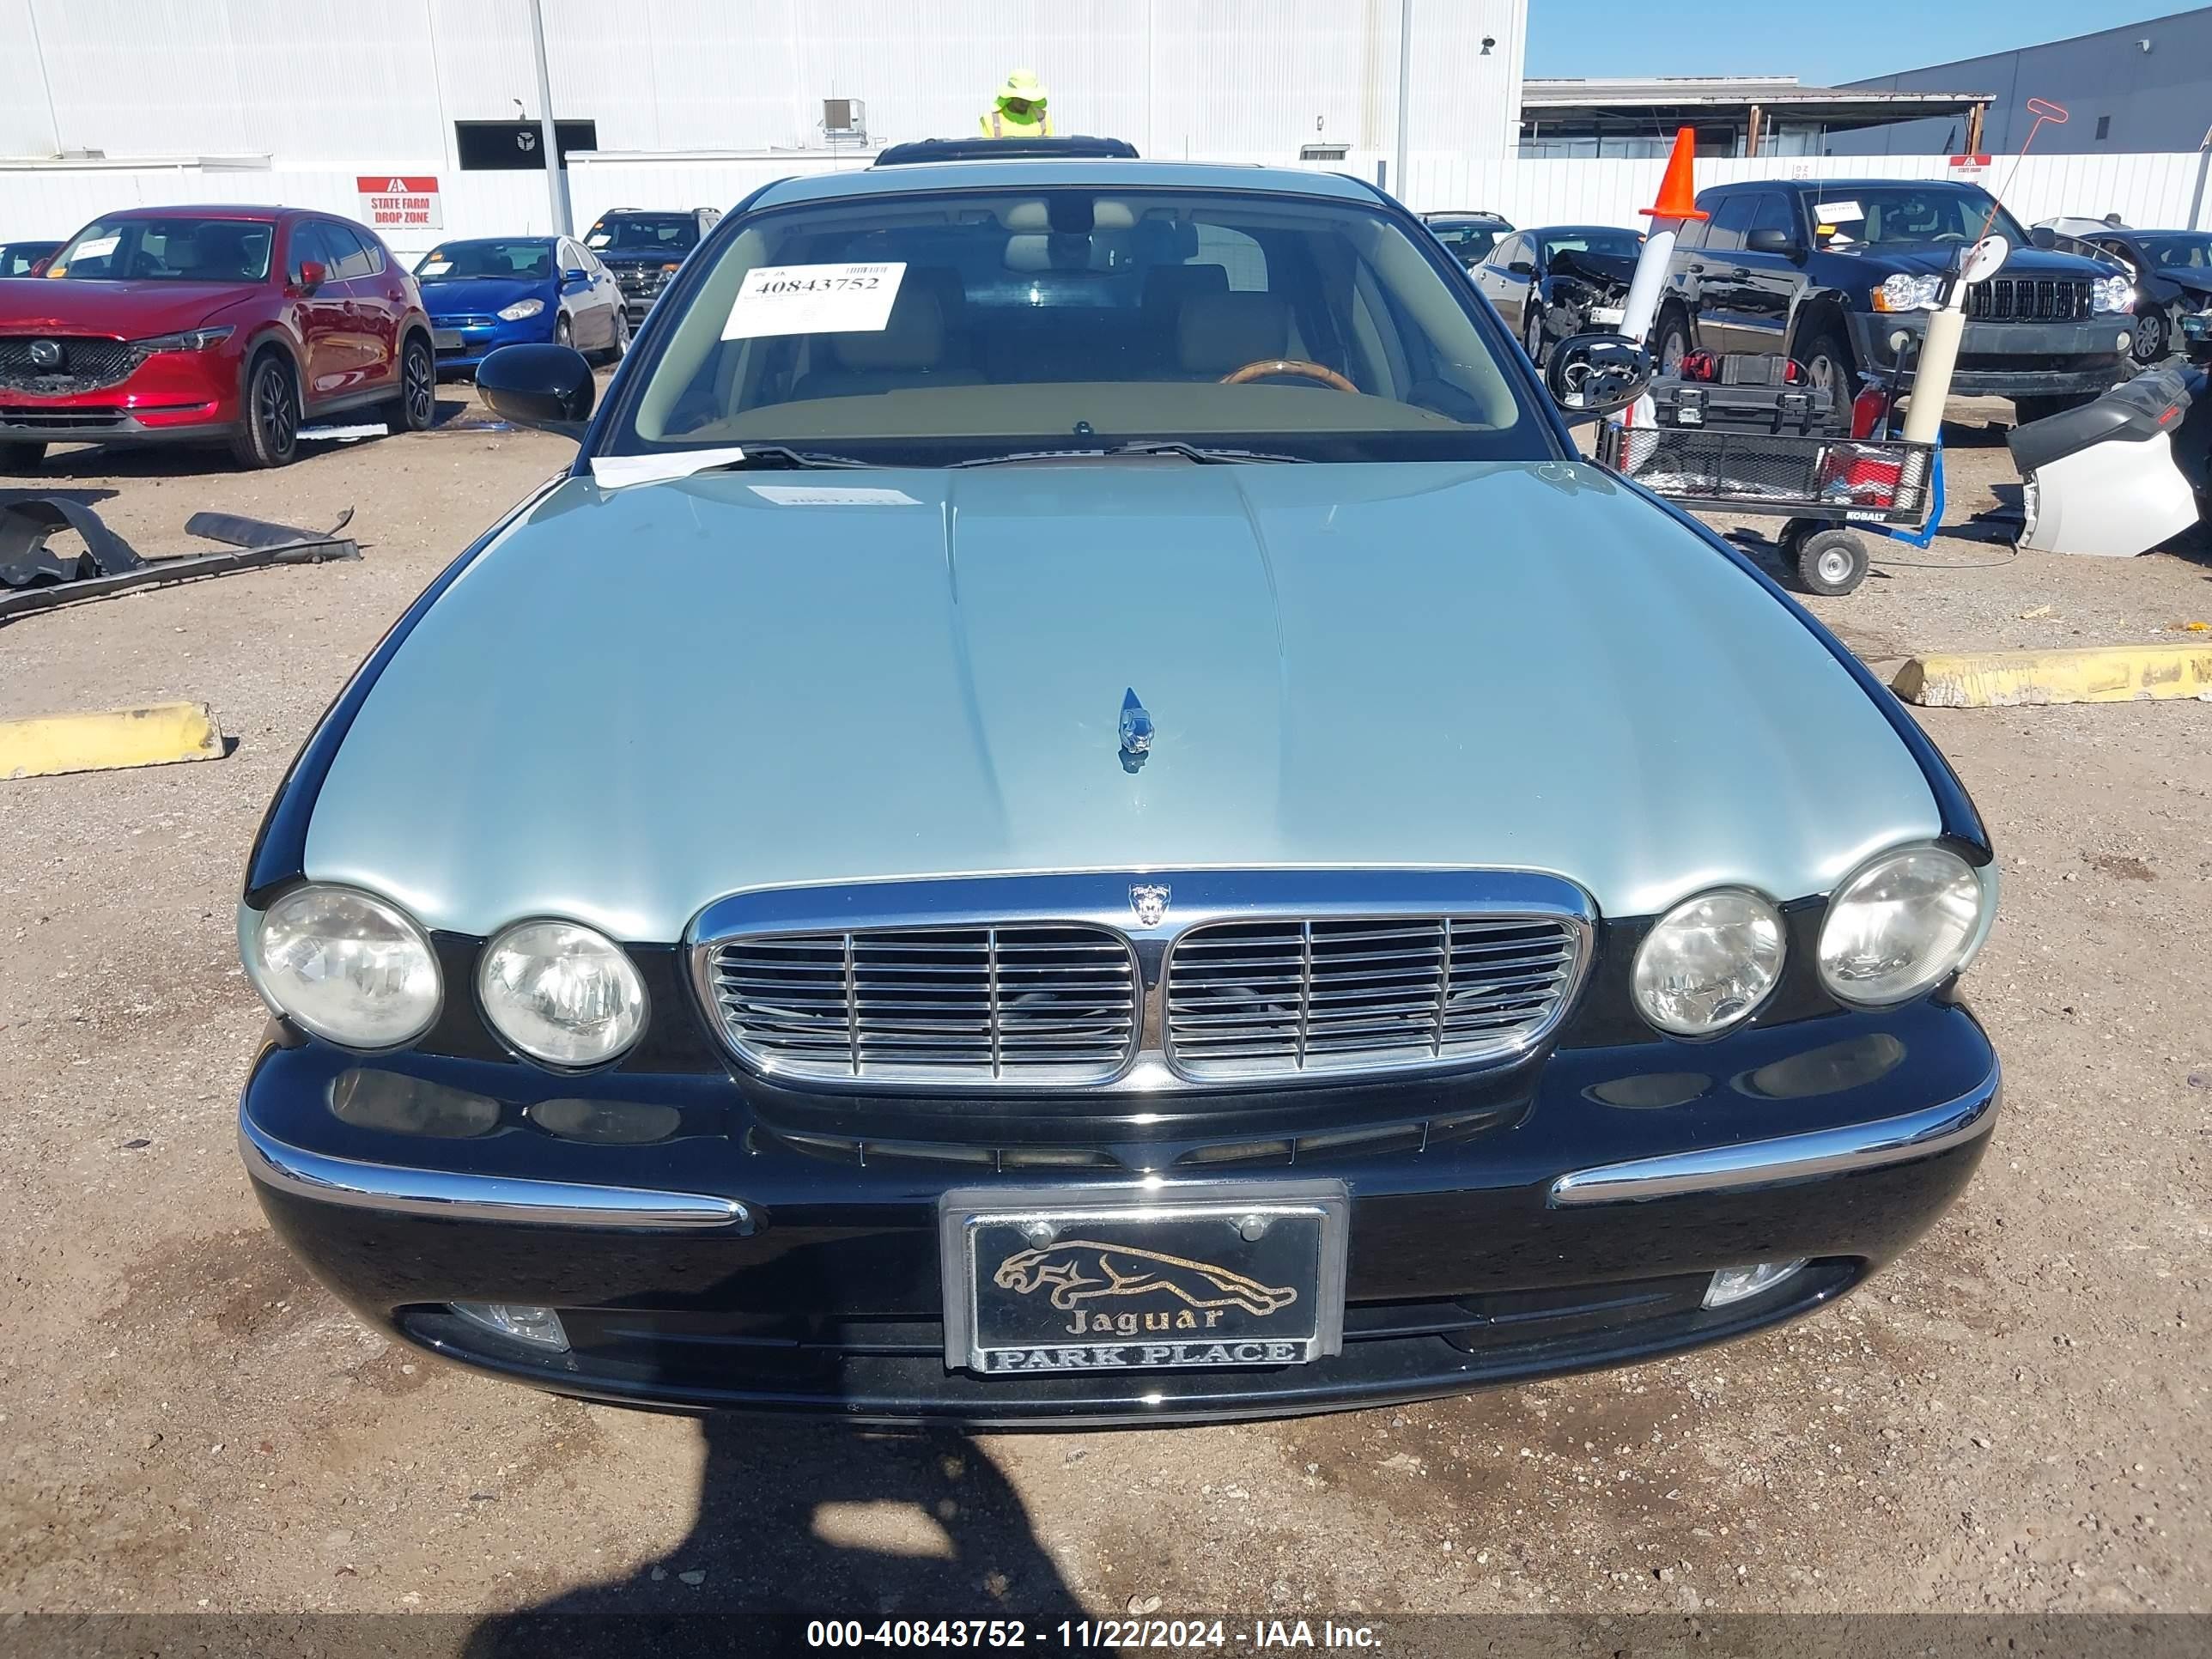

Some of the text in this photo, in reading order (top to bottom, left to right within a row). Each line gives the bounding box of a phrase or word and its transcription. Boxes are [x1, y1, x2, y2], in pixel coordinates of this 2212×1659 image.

[371, 198, 430, 210] STATE FARM
[375, 211, 429, 223] DROP ZONE
[755, 277, 880, 295] 40843752
[1846, 511, 1887, 522] KOBALT
[1065, 1309, 1224, 1336] Jaguar
[994, 1343, 1296, 1370] PARK PLACE
